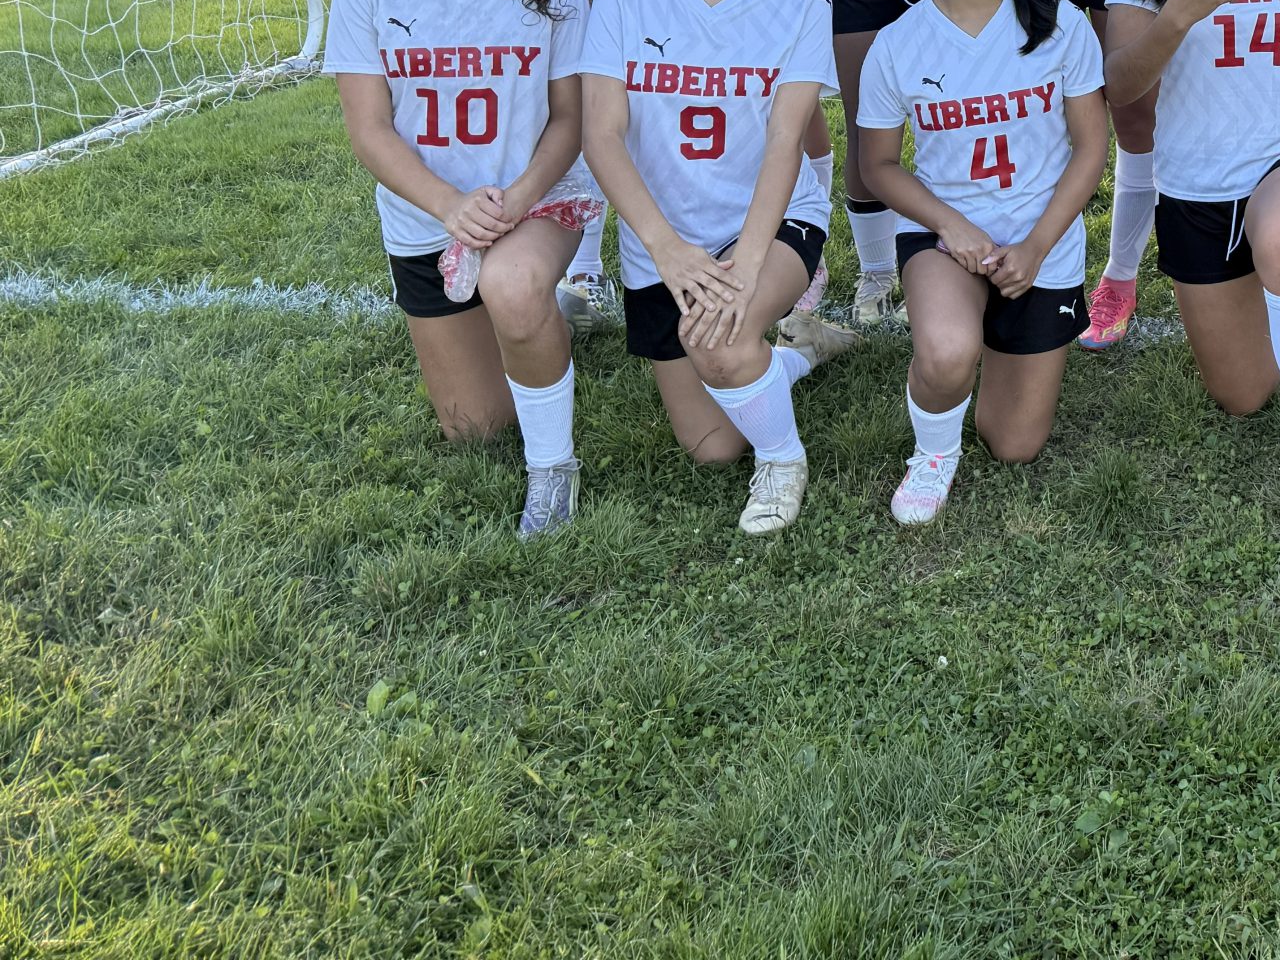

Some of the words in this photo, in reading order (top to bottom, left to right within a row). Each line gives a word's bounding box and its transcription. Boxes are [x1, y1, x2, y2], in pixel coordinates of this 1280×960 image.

[380, 45, 541, 79] LIBERTY
[626, 60, 781, 98] LIBERTY
[415, 88, 499, 147] 10
[680, 105, 728, 161] 9
[915, 81, 1057, 132] LIBERTY
[970, 135, 1016, 190] 4
